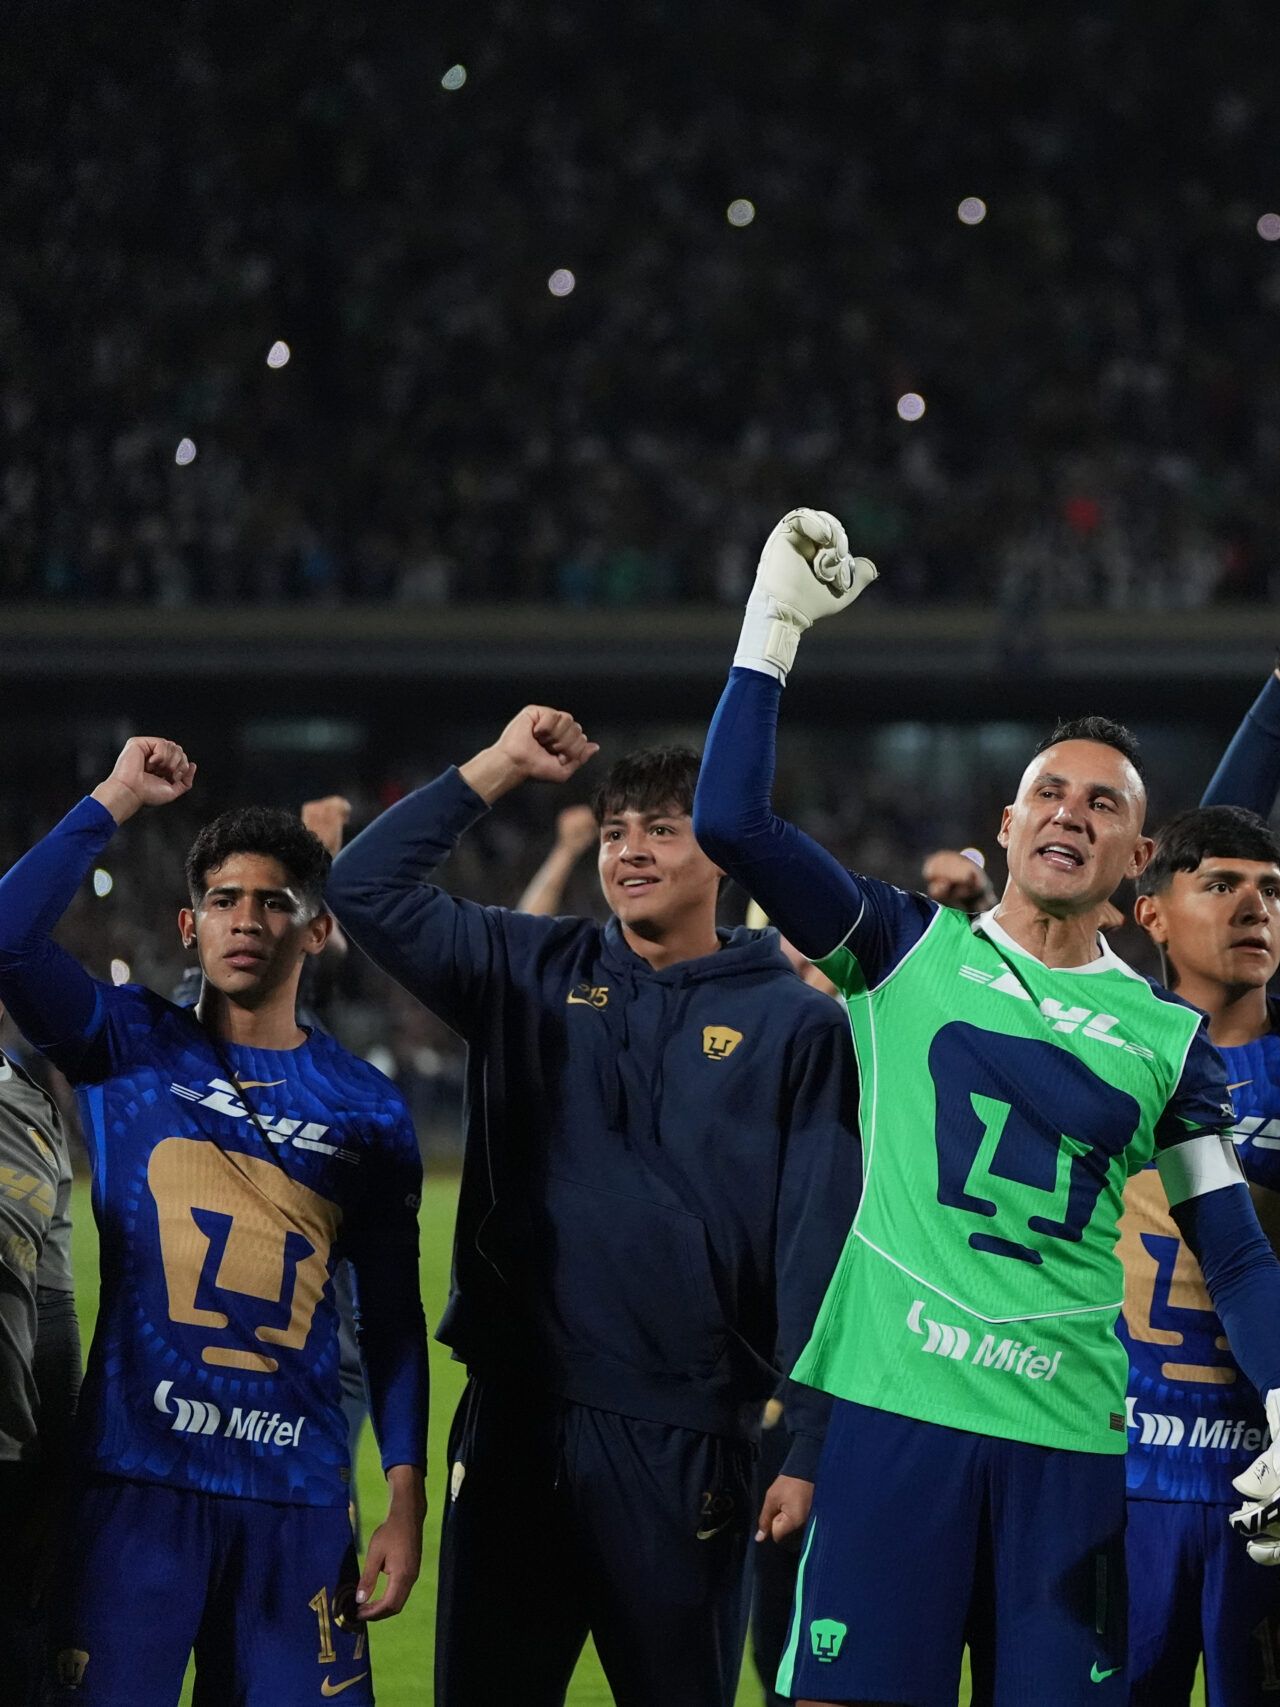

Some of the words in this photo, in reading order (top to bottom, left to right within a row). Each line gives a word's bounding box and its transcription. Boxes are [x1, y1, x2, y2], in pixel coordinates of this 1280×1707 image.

[198, 1077, 339, 1156] DHL
[971, 1334, 1063, 1382] Mifel
[223, 1407, 306, 1448] Mifel
